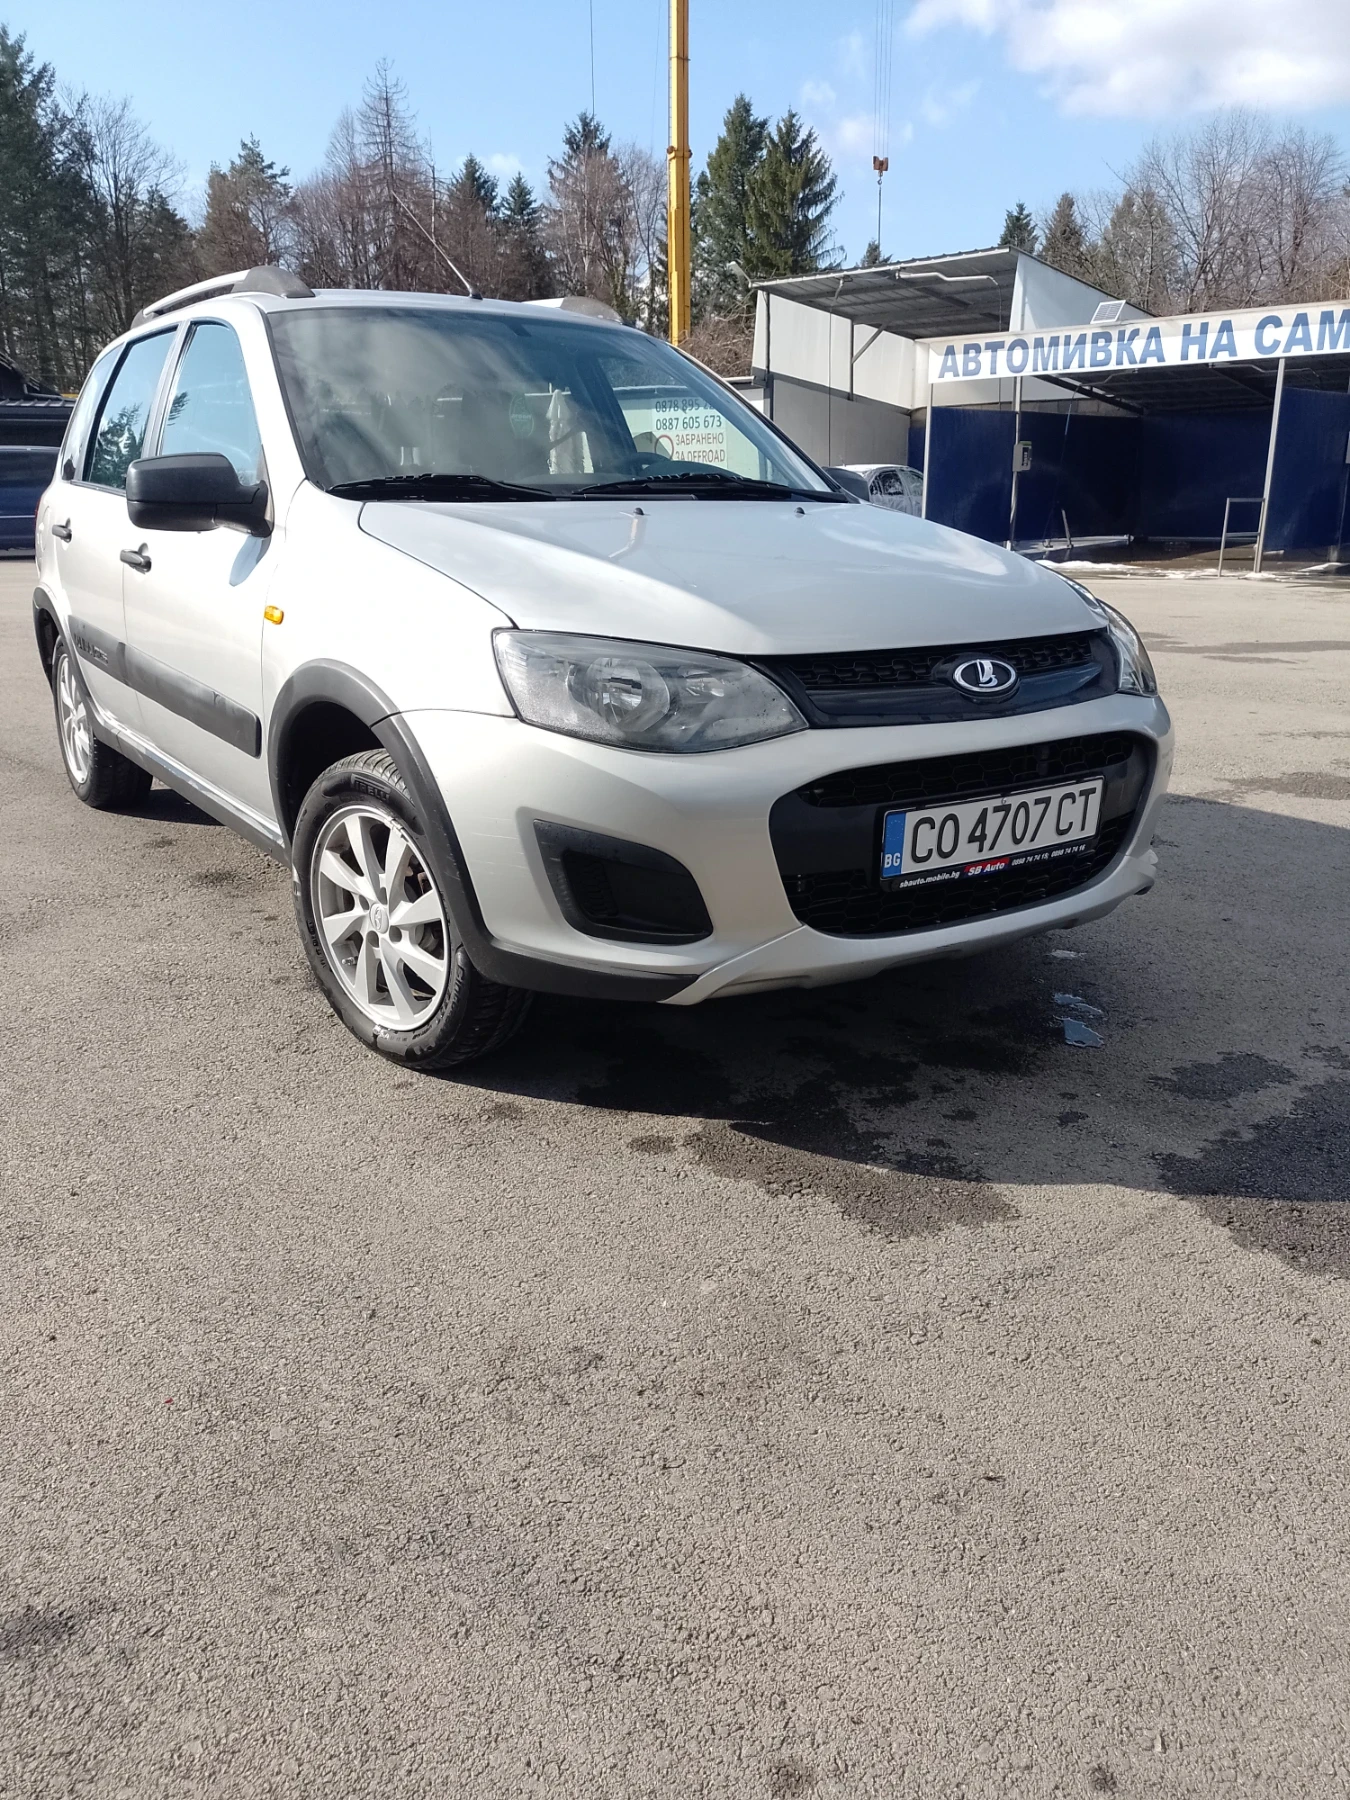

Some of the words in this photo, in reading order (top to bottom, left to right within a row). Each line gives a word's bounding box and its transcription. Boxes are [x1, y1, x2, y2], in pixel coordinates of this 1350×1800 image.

[938, 326, 1166, 379] АВТОМИВКА
[1180, 319, 1238, 361] НА
[1254, 308, 1350, 355] САМ
[655, 400, 679, 413] 0878
[681, 398, 700, 412] 895
[656, 417, 679, 430] 0887
[682, 416, 700, 429] 605
[703, 415, 722, 428] 673
[675, 432, 724, 446] ЗАБРАНЕНО
[687, 449, 726, 463] OFFROAD
[967, 796, 1052, 853] 4707
[884, 853, 900, 868] BG
[899, 871, 961, 888] sbauto.mobile.bg
[968, 866, 983, 876] SB
[984, 862, 1005, 873] Auto
